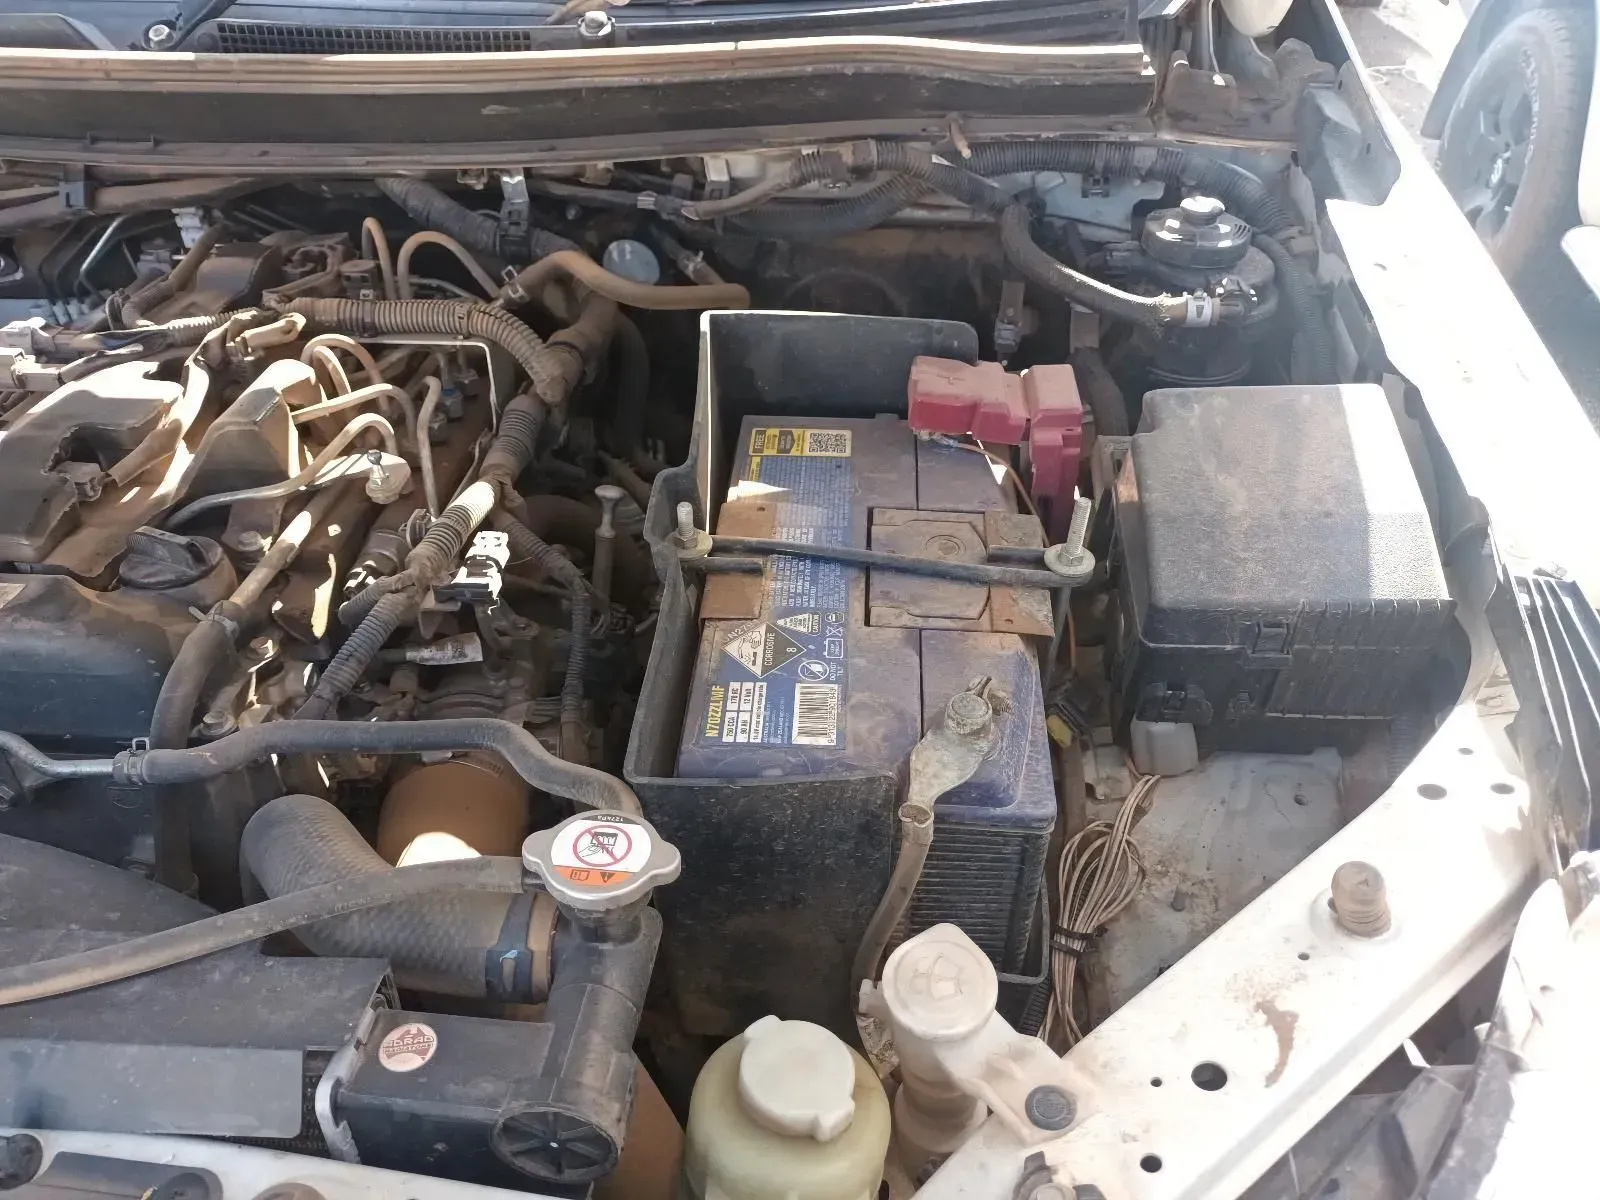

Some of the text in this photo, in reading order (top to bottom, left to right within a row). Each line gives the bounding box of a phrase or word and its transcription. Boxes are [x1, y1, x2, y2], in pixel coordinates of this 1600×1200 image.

[754, 434, 765, 449] FREE
[812, 614, 820, 633] CAUTION
[764, 632, 775, 666] CORROSIVE
[829, 672, 837, 681] DO
[705, 685, 725, 737] N70ZZLMF
